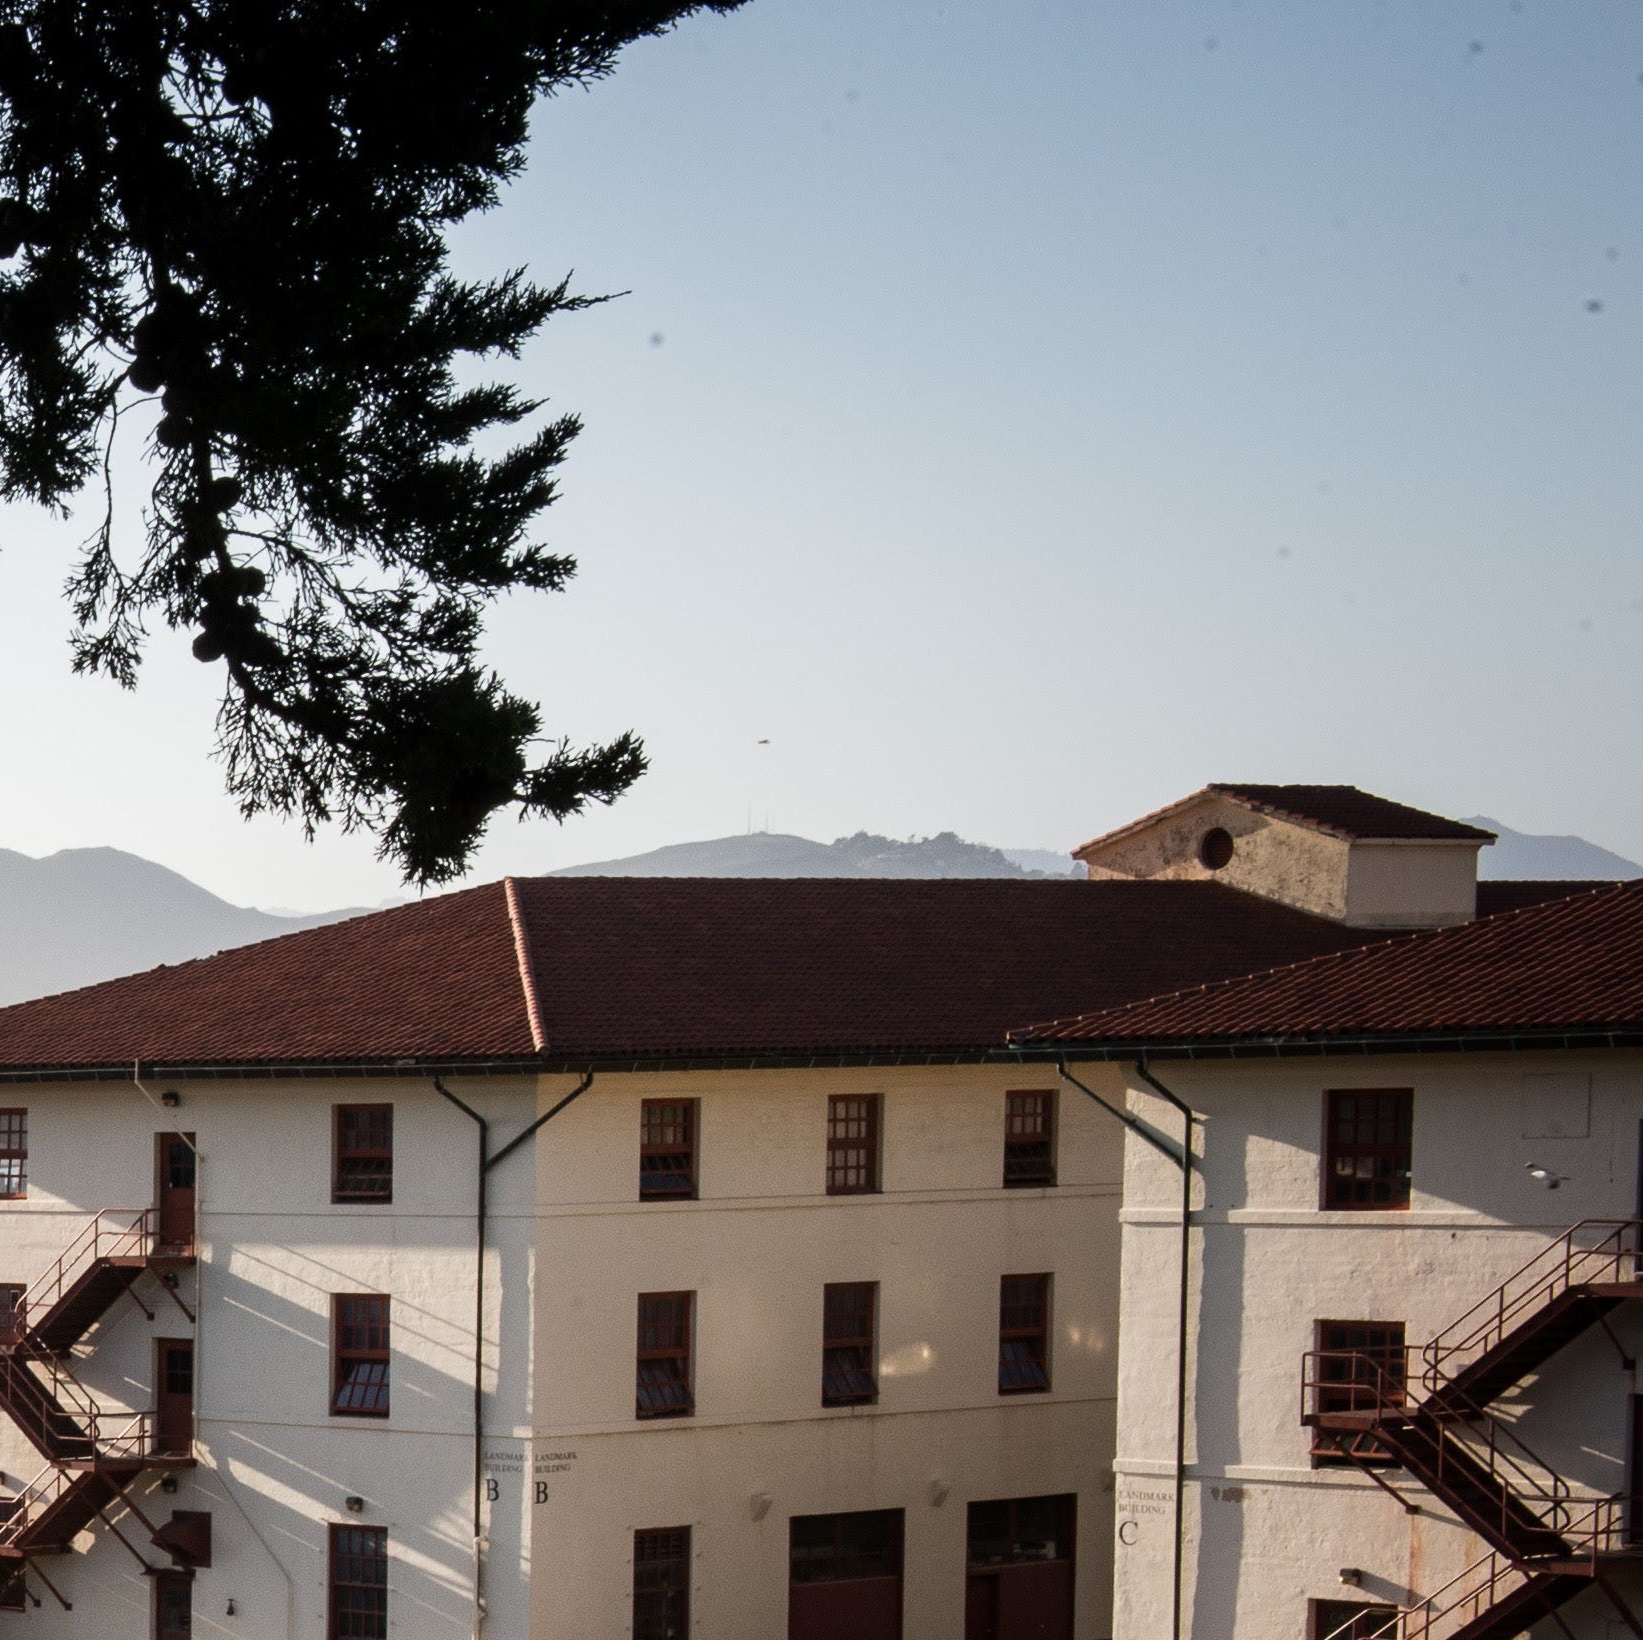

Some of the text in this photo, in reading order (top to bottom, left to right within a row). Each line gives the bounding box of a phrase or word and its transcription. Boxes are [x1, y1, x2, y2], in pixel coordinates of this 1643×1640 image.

[535, 1452, 578, 1461] LANDMARK
[485, 1479, 500, 1502] B
[535, 1481, 549, 1504] B
[1119, 1491, 1175, 1502] LANDMARK
[1119, 1504, 1166, 1515] BUILDING
[1119, 1521, 1139, 1546] C
